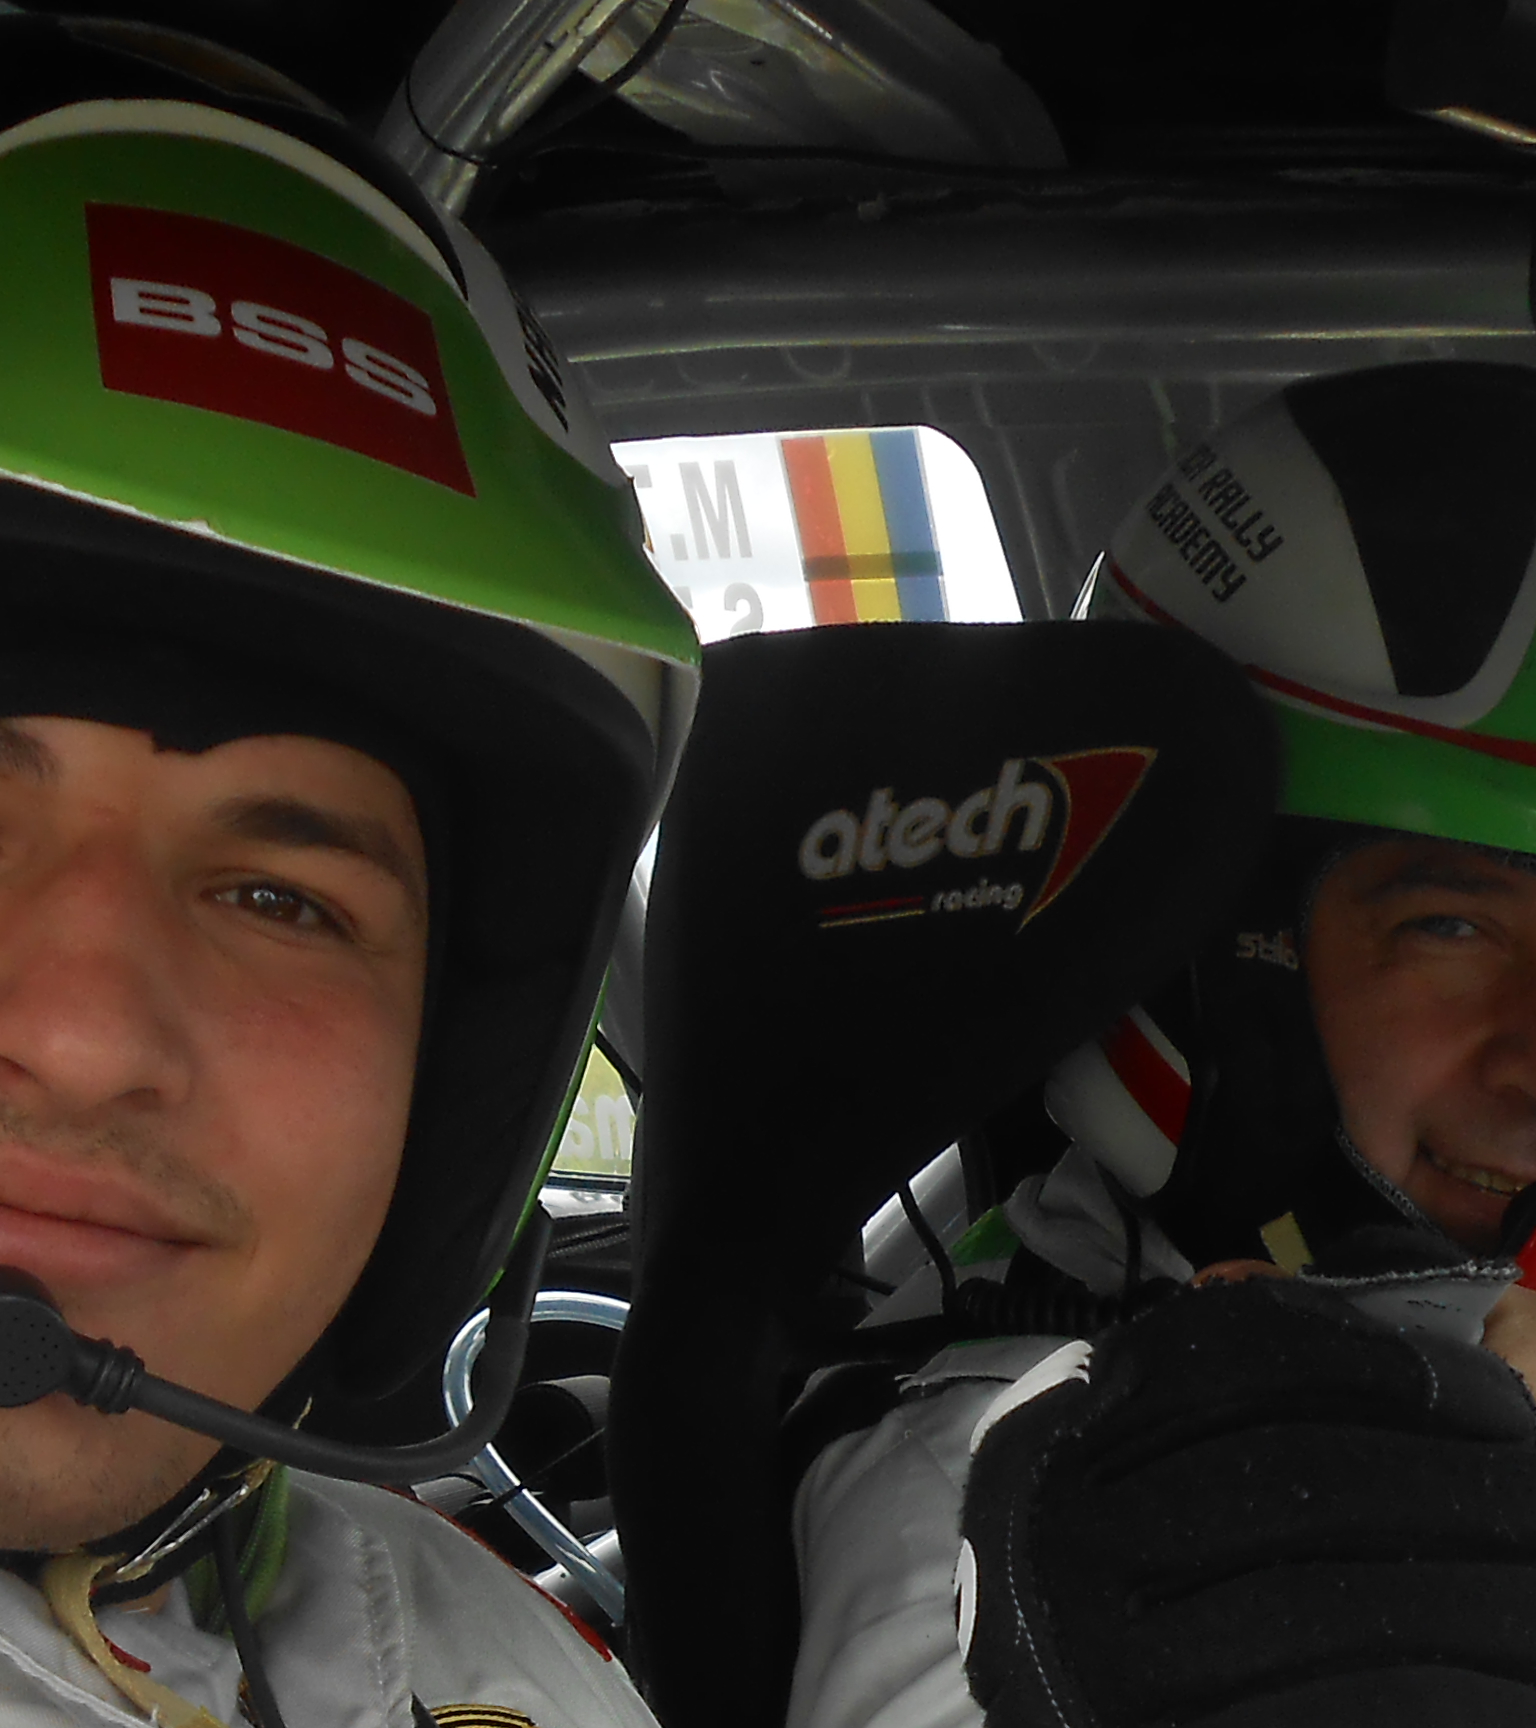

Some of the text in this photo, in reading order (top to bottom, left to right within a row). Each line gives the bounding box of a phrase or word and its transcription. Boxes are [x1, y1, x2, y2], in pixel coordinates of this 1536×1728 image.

[108, 276, 438, 417] BSS
[1146, 483, 1247, 602] ACADEMY
[1197, 467, 1285, 563] RALLY
[798, 758, 1053, 880] atech
[931, 877, 1024, 912] racing
